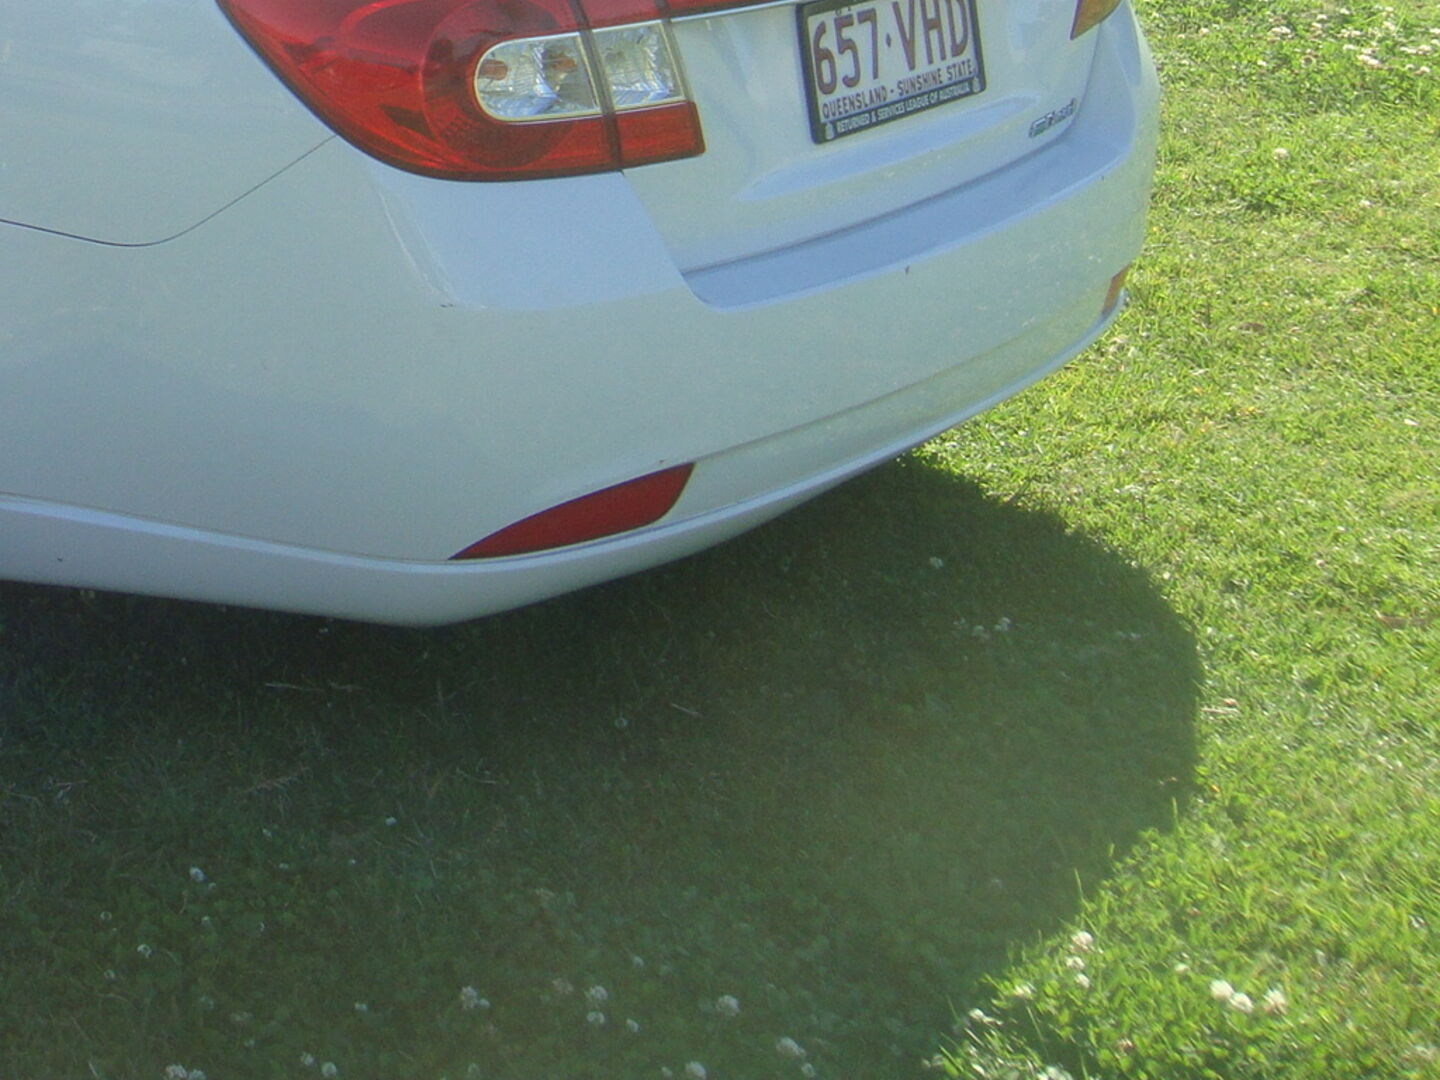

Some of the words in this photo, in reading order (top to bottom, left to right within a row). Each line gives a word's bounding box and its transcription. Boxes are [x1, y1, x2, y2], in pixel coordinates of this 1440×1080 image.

[823, 85, 888, 119] QUEENSLAND
[897, 68, 943, 96] SUNSHINE
[946, 58, 973, 81] STATE
[837, 113, 870, 132] RETURNED
[877, 101, 905, 120] SERVICES
[906, 95, 930, 112] LEAGUE
[929, 90, 939, 105] OF
